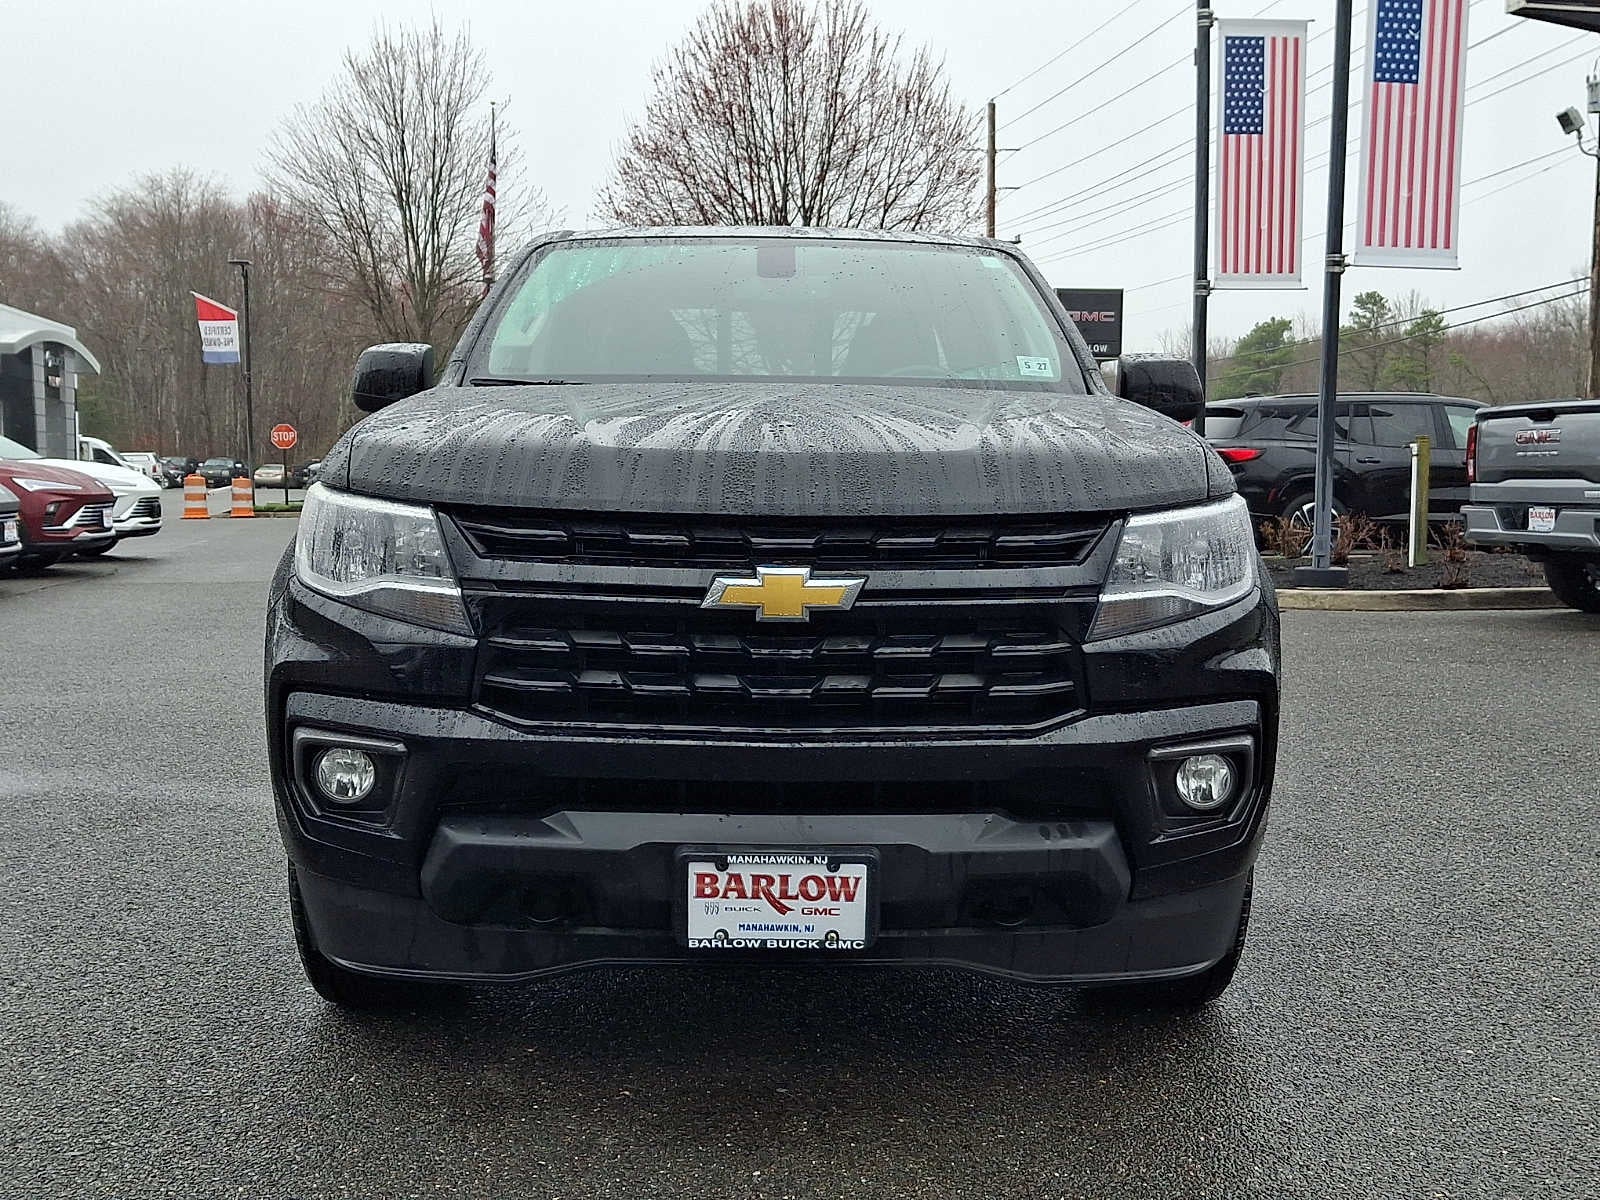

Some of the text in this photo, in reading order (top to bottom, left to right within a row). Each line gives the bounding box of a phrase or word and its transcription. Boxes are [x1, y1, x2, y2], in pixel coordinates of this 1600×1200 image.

[1087, 344, 1108, 353] LOW
[1024, 361, 1048, 371] 5 27
[273, 431, 295, 441] STOP
[1516, 429, 1561, 445] GMC
[727, 855, 829, 865] MANAHAWKIN, NJ
[693, 872, 862, 915] BARLOW
[801, 907, 841, 916] GMC
[738, 923, 815, 934] MANAHAWKIN, NJ
[688, 937, 865, 950] BARLOW BUICK GMC
